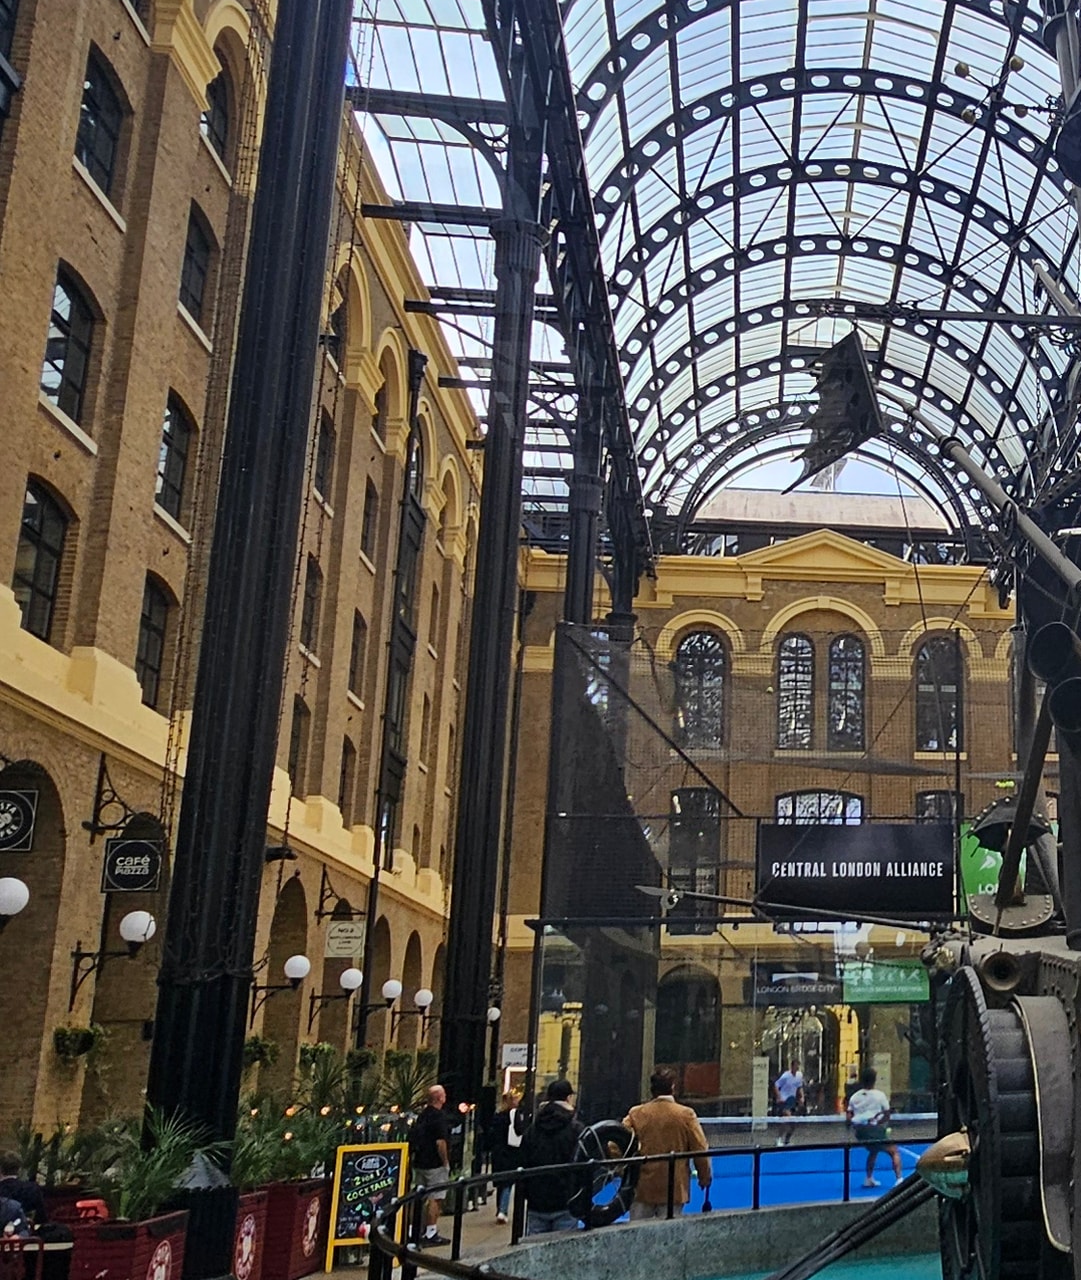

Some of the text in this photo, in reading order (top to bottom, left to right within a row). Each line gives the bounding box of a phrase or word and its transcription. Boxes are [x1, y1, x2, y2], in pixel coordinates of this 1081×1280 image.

[772, 862, 943, 878] CENTRAL LONDON ALLIANCE
[346, 1177, 394, 1201] COCKTAILS
[353, 1176, 361, 1186] 2
